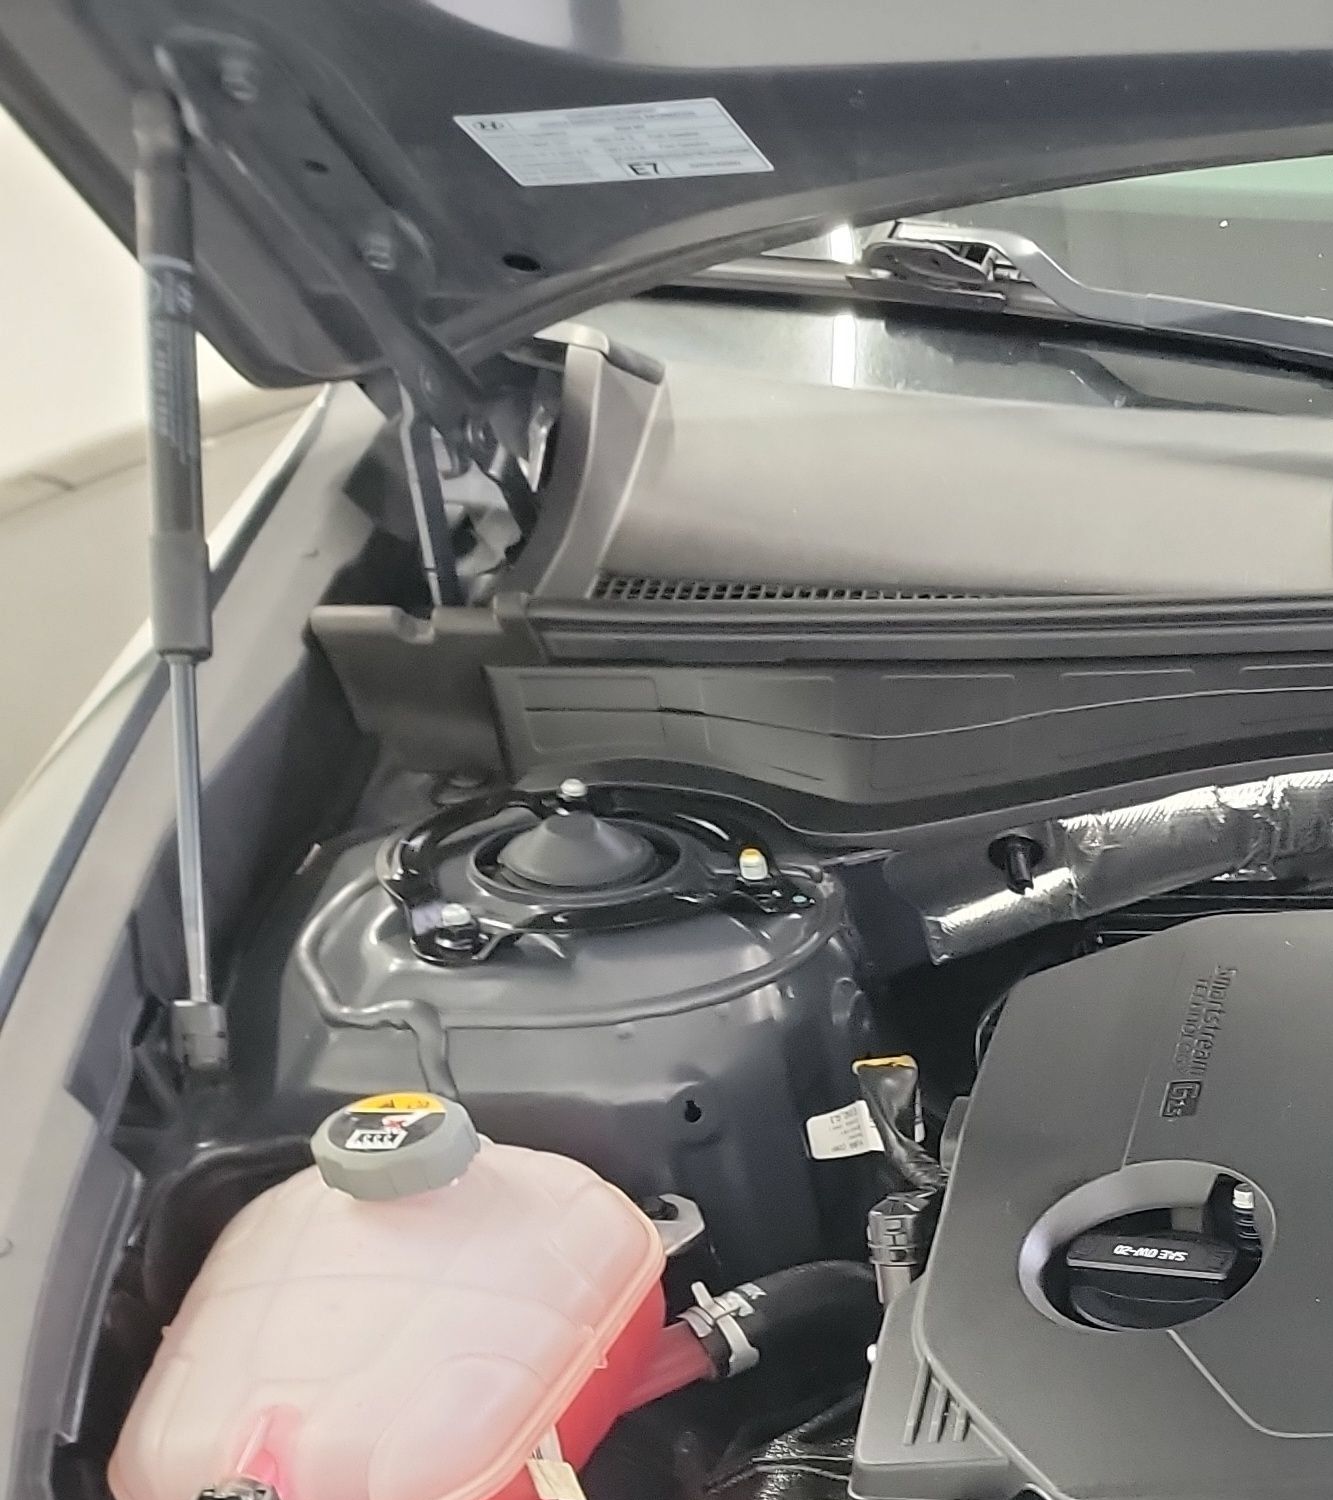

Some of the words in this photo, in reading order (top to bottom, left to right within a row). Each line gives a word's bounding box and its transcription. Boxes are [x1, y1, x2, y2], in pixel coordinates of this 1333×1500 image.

[629, 162, 659, 176] E7
[1113, 1244, 1159, 1258] 0W-20
[1157, 1249, 1188, 1262] SAE
